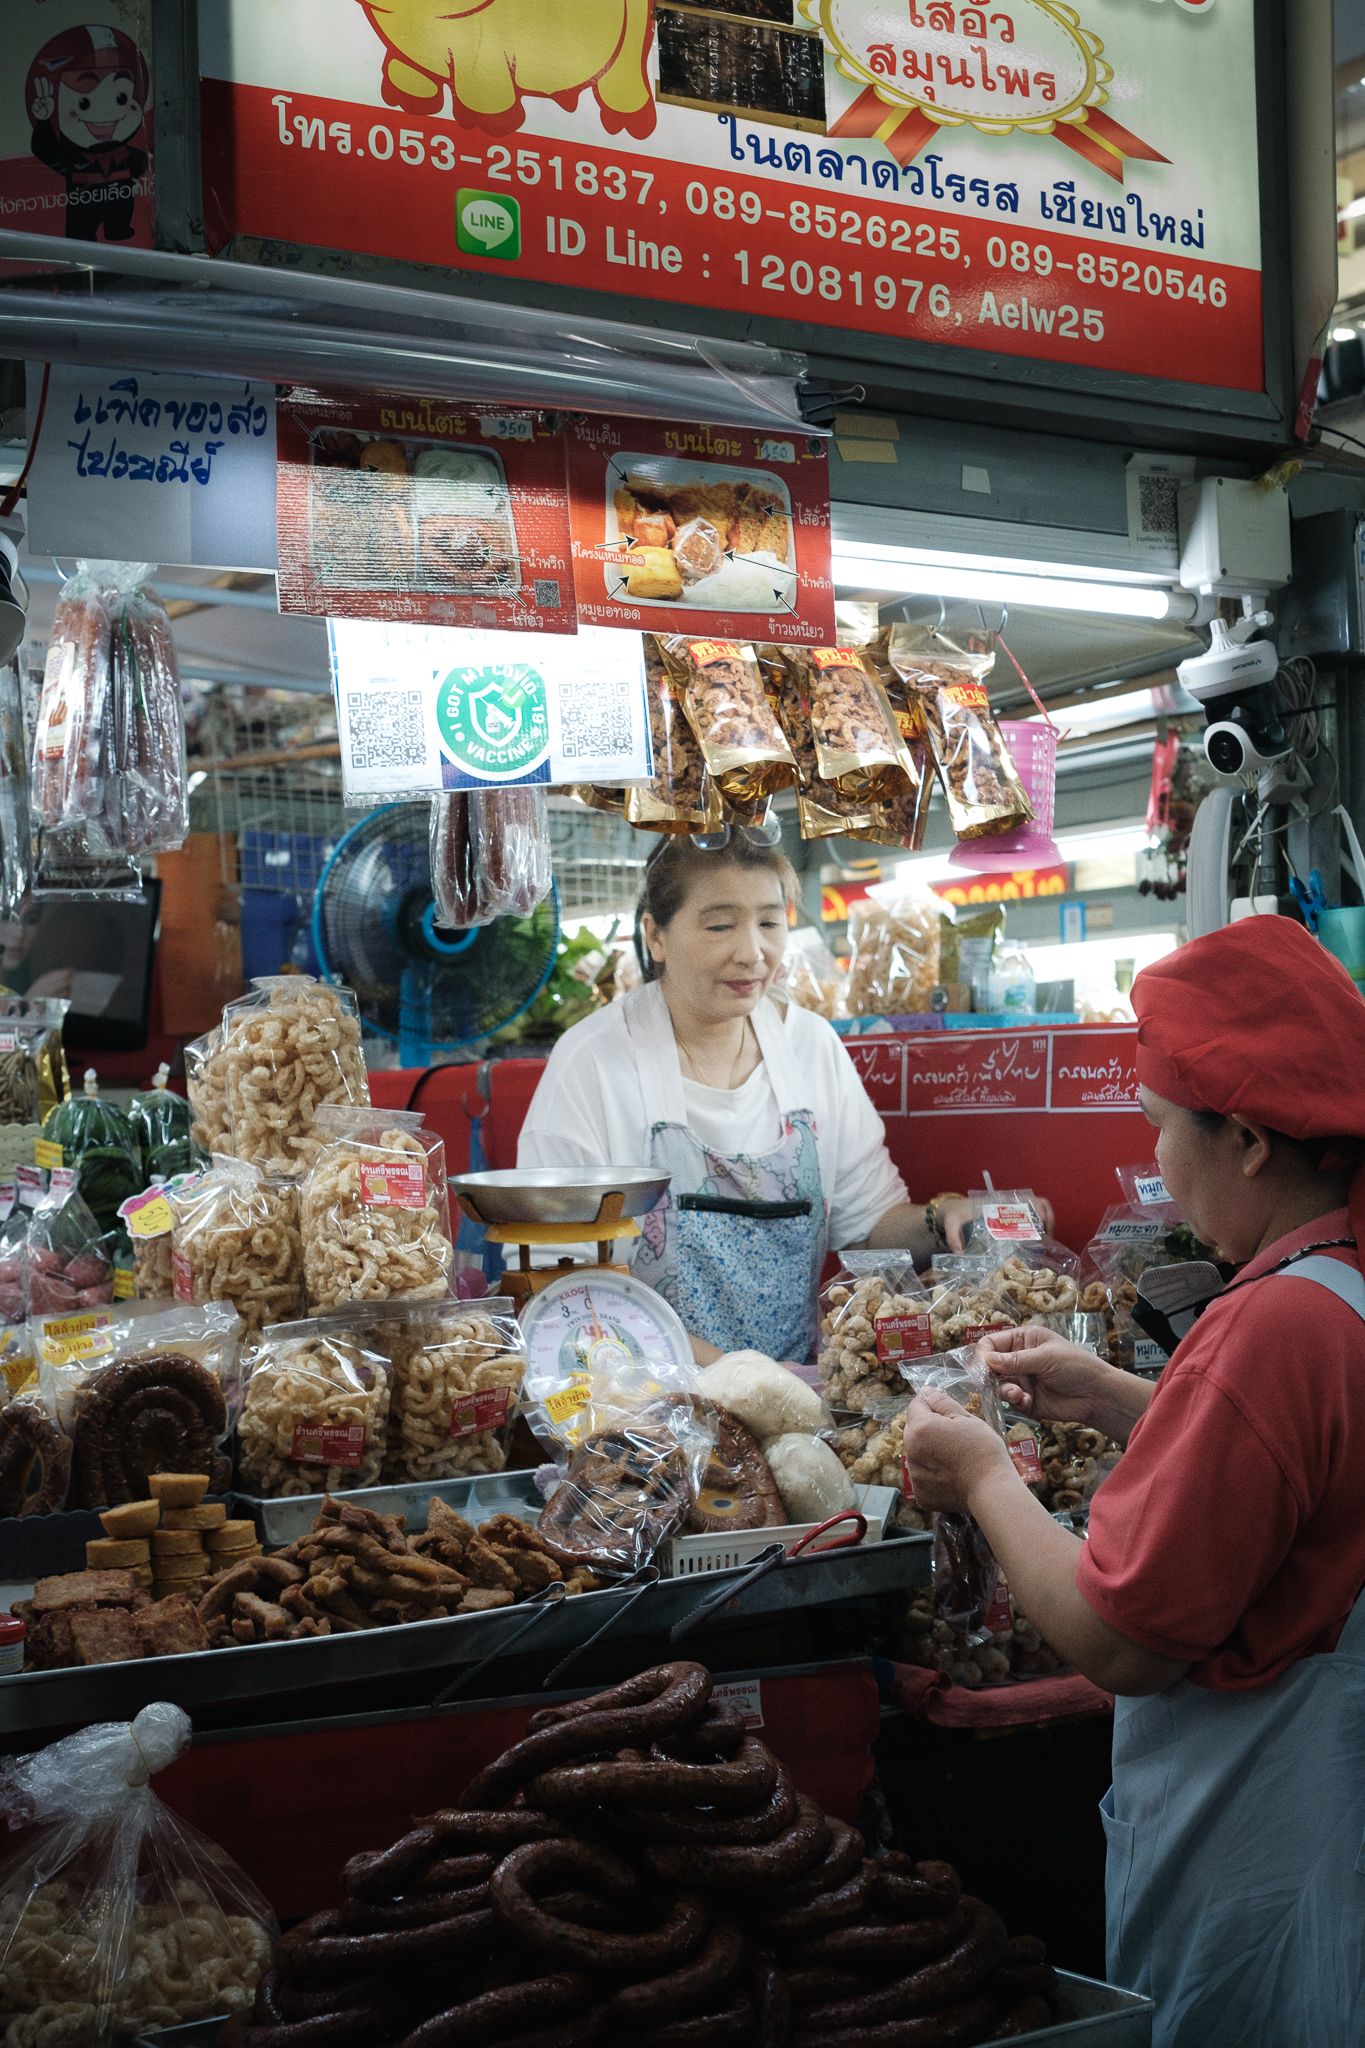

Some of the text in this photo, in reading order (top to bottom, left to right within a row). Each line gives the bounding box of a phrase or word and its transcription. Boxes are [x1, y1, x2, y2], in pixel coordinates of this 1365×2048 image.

[866, 44, 1057, 104] สมุนไพร
[718, 115, 1206, 249] ในตลาดวโรรส เชียงใหม่
[272, 96, 1228, 309] โทร.053-251837, 089-8526225, 089-8520546
[471, 212, 505, 231] LINE
[547, 216, 586, 257] ID
[606, 226, 683, 273] Line
[733, 249, 963, 328] 12081976,
[978, 292, 1105, 343] Aelw25
[380, 399, 466, 435] เบนโตะ
[665, 424, 742, 457] เบนโตะ
[578, 602, 641, 623] หมูยอทอด
[768, 619, 825, 639] ข้าวเหนียว
